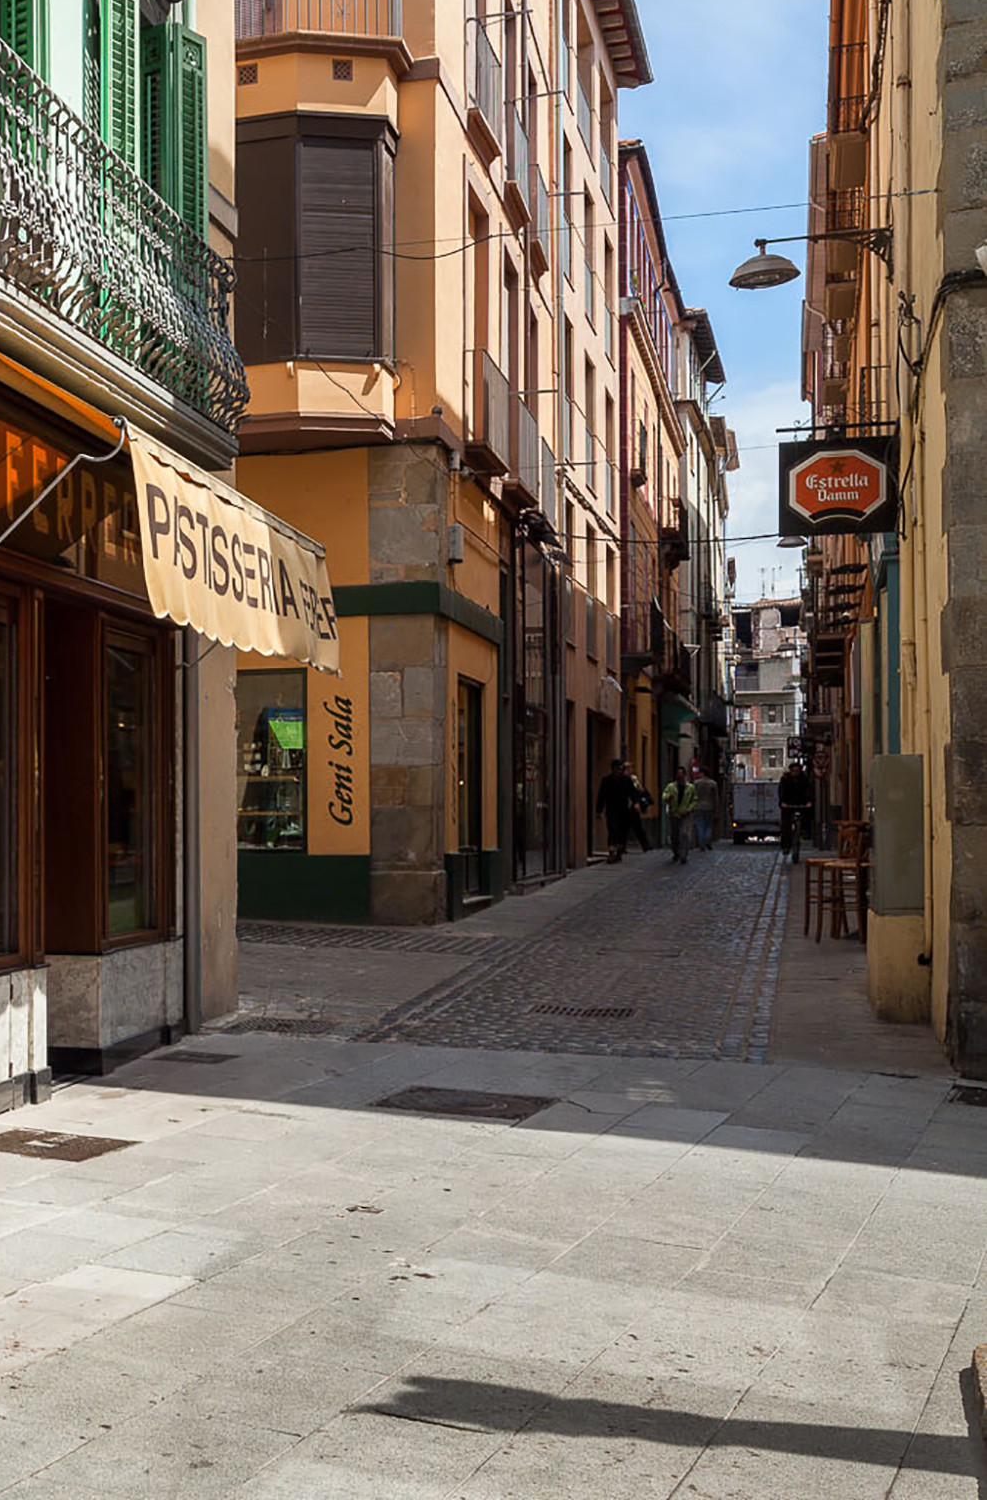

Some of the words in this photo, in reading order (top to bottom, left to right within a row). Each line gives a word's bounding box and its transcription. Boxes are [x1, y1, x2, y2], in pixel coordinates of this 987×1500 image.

[806, 474, 868, 489] Estrella
[818, 489, 858, 501] Damm
[323, 695, 354, 756] Sala
[328, 761, 354, 827] Geni
